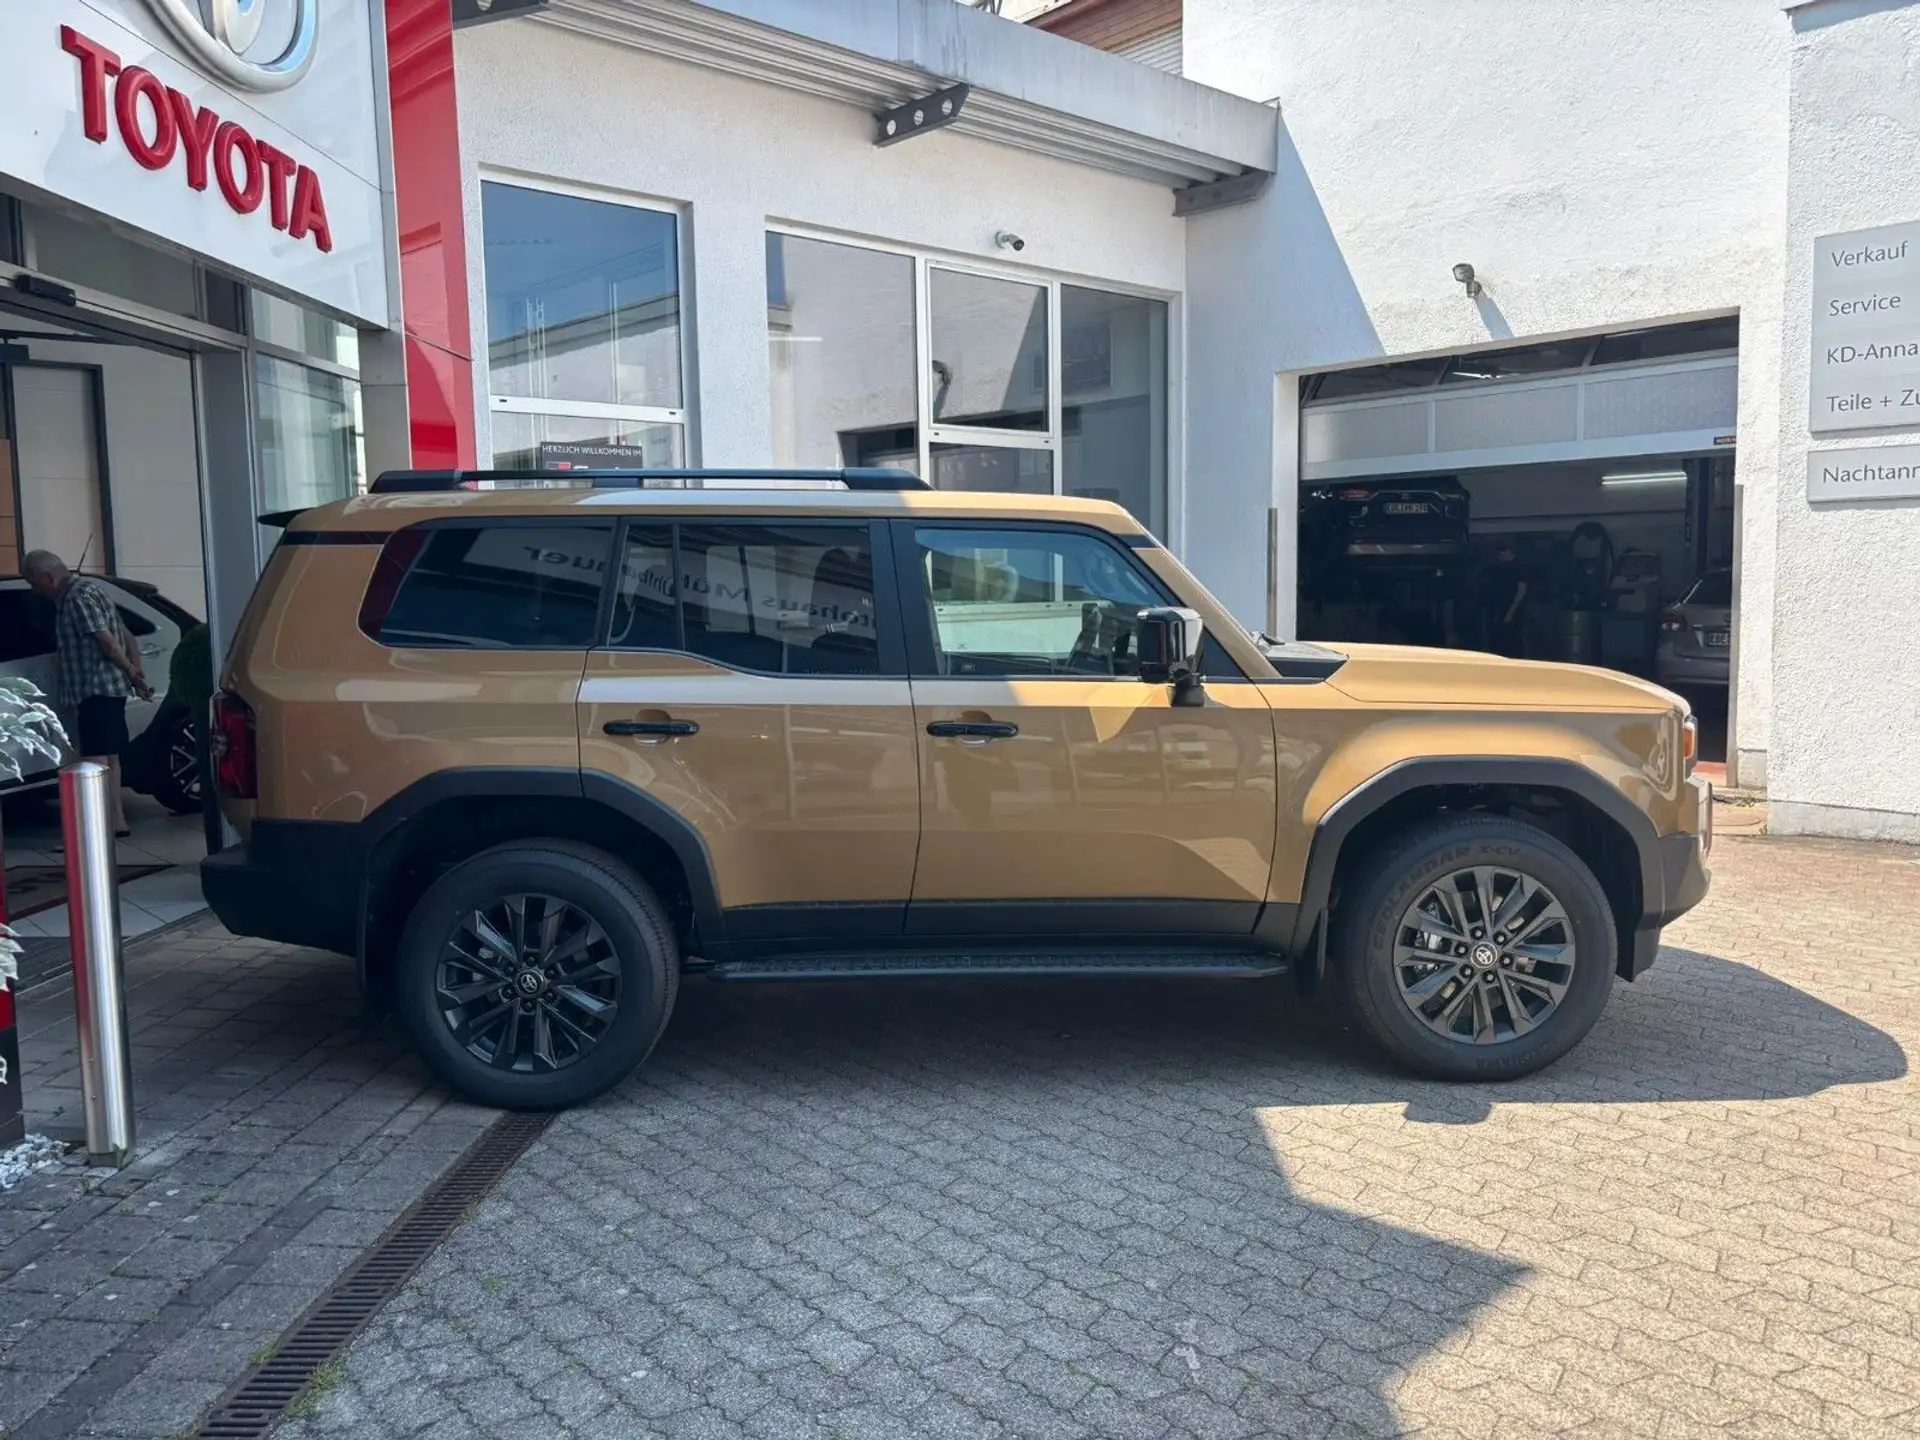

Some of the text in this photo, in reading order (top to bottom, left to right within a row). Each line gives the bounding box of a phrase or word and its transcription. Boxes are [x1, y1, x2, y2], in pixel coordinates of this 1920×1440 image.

[60, 24, 332, 253] TOYOTA
[1831, 240, 1908, 267] Verkauf
[1828, 294, 1902, 317] Service
[1826, 393, 1872, 412] Teile
[1879, 395, 1892, 407] +
[542, 445, 580, 454] HERZLICH
[581, 446, 631, 456] WILLKOMMEN
